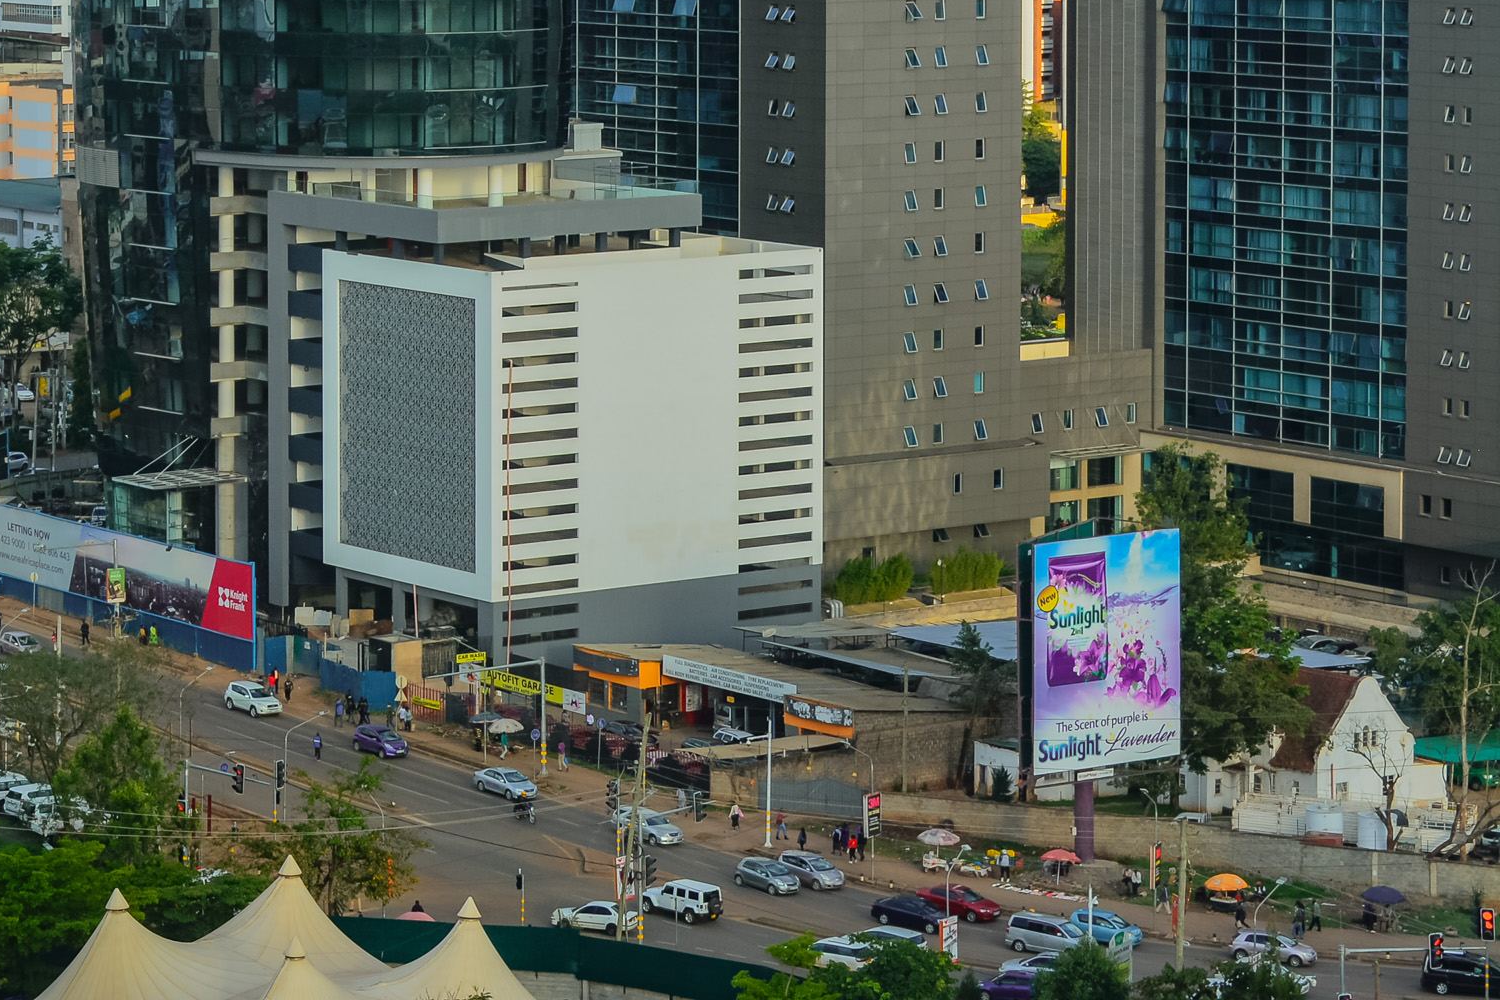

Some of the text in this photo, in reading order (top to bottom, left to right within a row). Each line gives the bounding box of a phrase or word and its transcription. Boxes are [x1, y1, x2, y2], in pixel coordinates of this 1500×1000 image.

[7, 522, 51, 540] LETTING NOW
[1, 534, 11, 545] 423
[12, 537, 26, 550] 9000
[230, 589, 248, 602] Knight
[1039, 592, 1056, 606] New
[230, 600, 246, 612] Frank
[1049, 603, 1106, 629] Sunlight
[486, 670, 519, 686] AUTOFIT
[684, 661, 708, 671] DIAGNOSTICS
[718, 669, 746, 680] CONDITIONING
[757, 678, 785, 689] REPLACEMENT
[731, 684, 742, 692] WASH
[744, 681, 770, 692] SUSPENSIONS
[1056, 710, 1149, 733] The Scent of purple is
[1038, 723, 1177, 763] Sunlight Lavender
